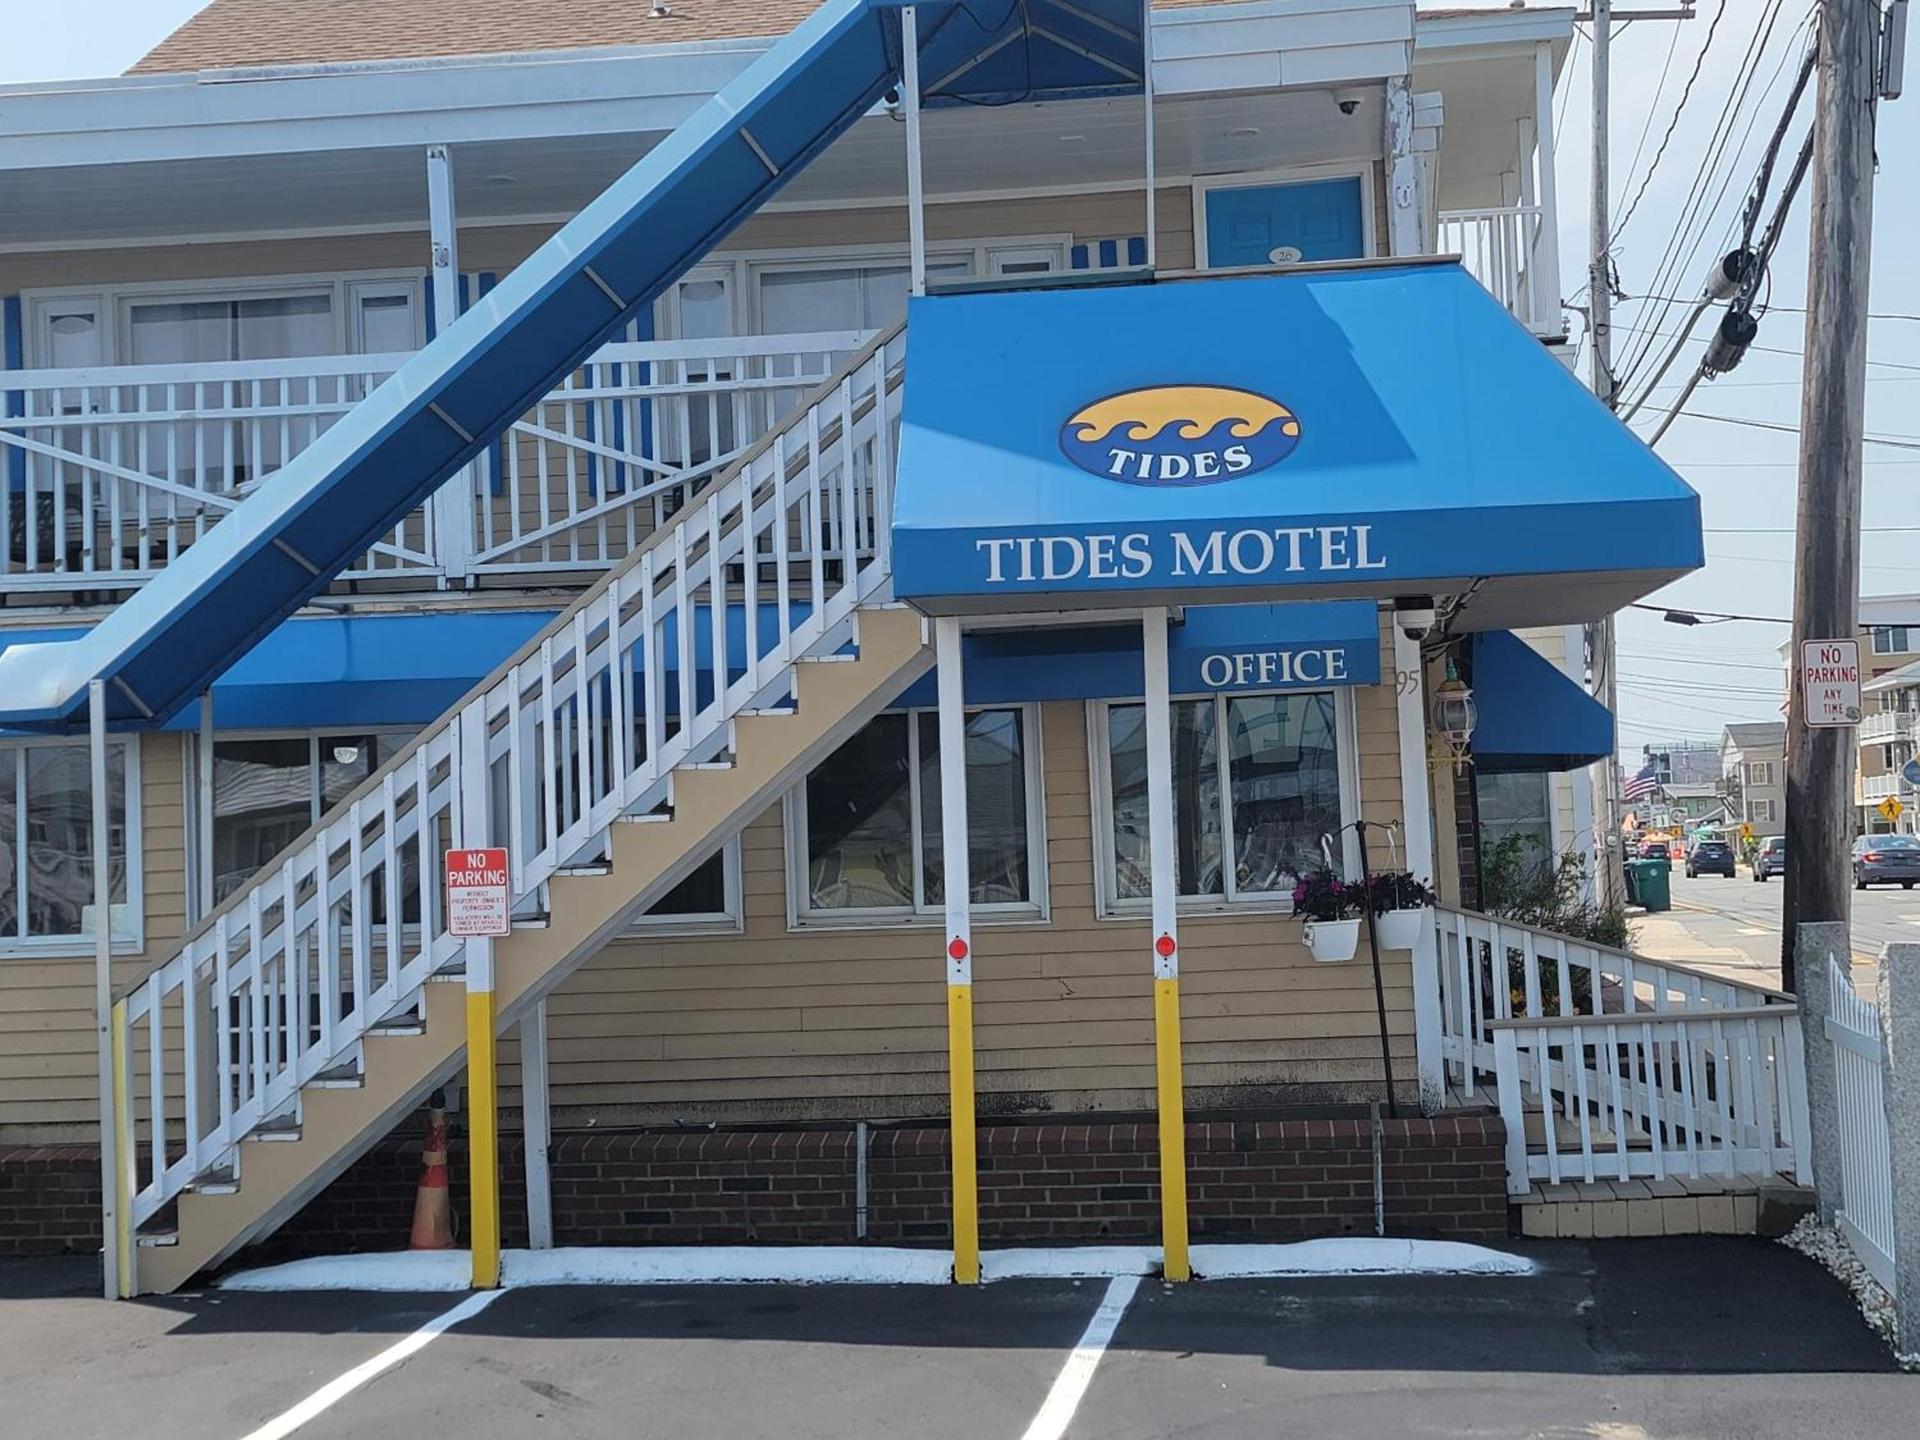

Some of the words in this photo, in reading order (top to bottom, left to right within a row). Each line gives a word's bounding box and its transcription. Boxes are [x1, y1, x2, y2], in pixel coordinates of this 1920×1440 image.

[1107, 444, 1252, 480] TIDES
[975, 533, 1153, 582] TIDES
[1169, 525, 1387, 576] MOTEL
[1820, 648, 1841, 664] NO
[1201, 649, 1348, 687] OFFICE
[1807, 666, 1857, 683] PARKING
[1397, 669, 1420, 696] 95
[1824, 689, 1842, 700] ANY
[1823, 703, 1843, 714] TIME
[467, 853, 486, 869] NO
[449, 870, 506, 886] PARKING
